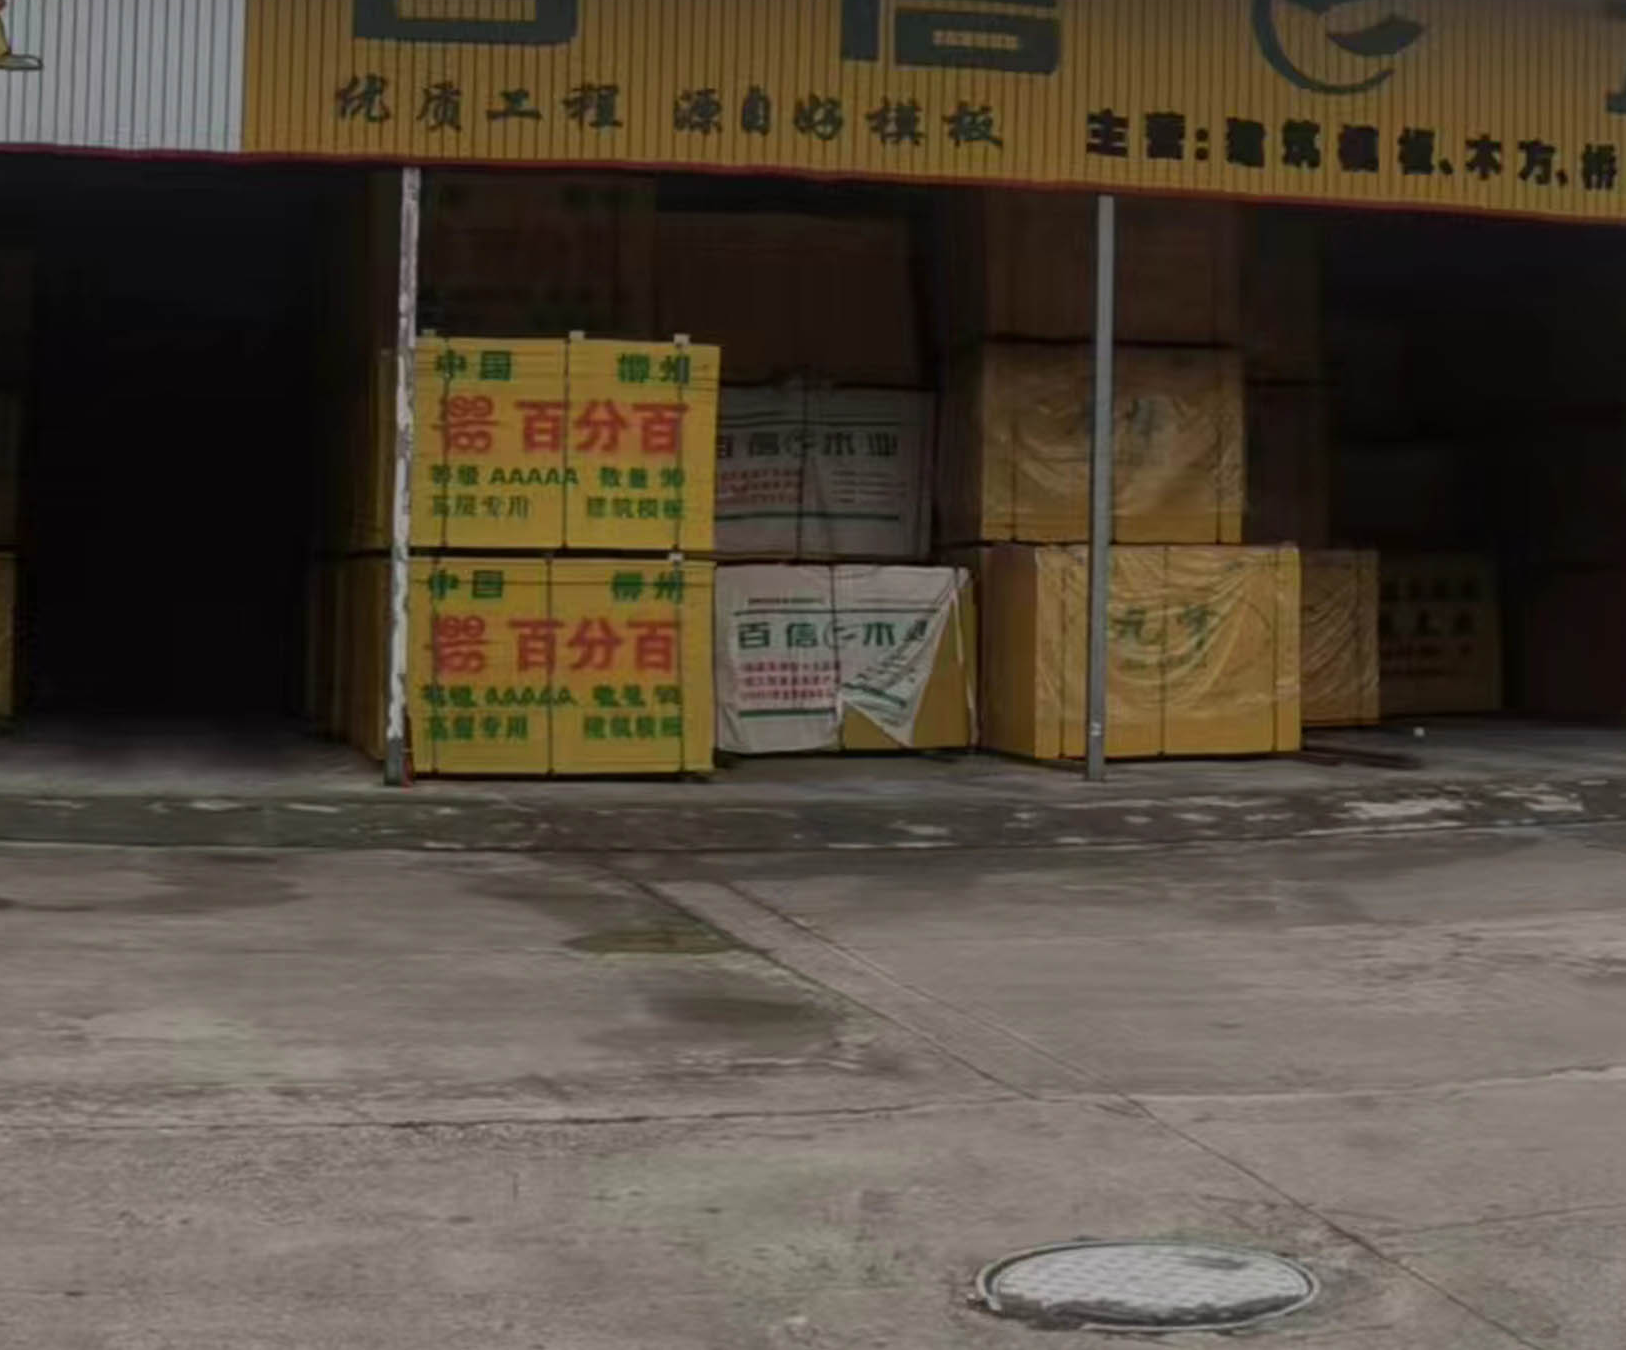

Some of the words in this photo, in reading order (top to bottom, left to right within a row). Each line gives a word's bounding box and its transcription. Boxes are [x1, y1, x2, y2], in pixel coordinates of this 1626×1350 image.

[334, 73, 625, 135] 优质工程
[671, 84, 1004, 151] 源自好模板
[513, 398, 691, 455] 百分百
[506, 615, 681, 674] 百分百
